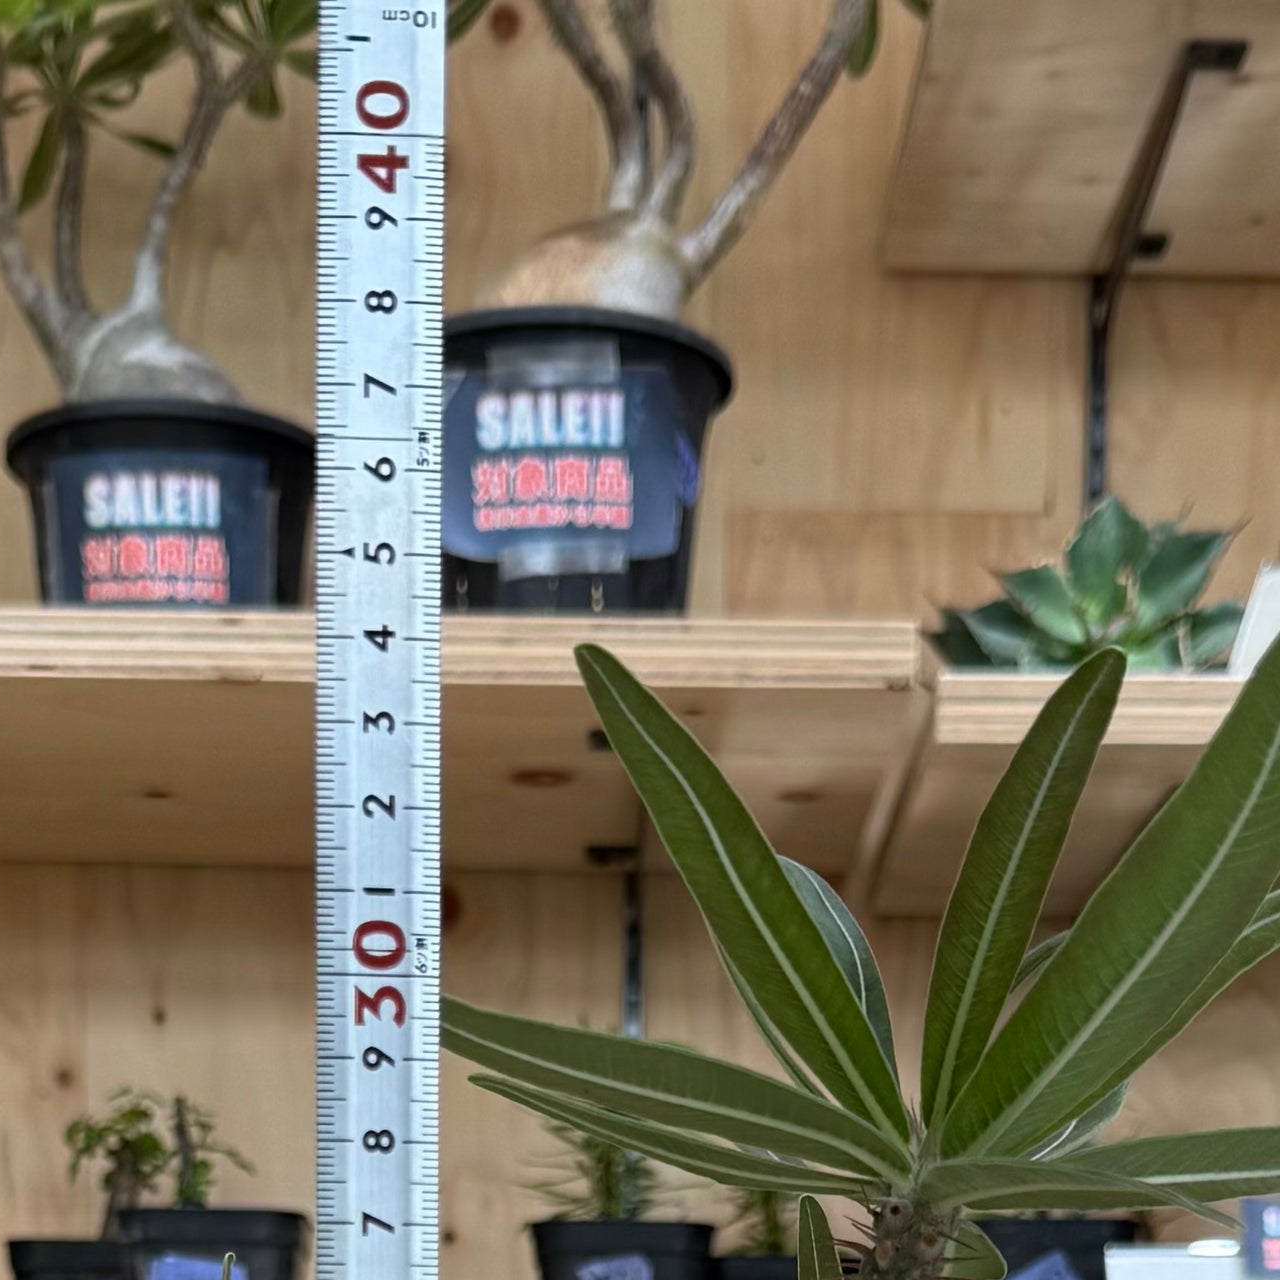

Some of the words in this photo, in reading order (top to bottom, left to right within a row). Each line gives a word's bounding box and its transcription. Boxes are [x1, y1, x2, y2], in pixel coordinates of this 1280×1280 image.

[381, 9, 438, 29] 10cm
[346, 34, 371, 42] 1
[355, 79, 411, 194] 40
[364, 206, 399, 230] 9
[364, 289, 398, 315] 8
[363, 373, 397, 398] 7
[363, 456, 396, 483] 6
[363, 541, 396, 566] 5
[363, 624, 396, 652] 4
[363, 711, 395, 734] 3
[362, 794, 396, 820] 2
[362, 887, 396, 896] 1
[352, 919, 407, 1027] 30
[362, 1046, 395, 1071] 9
[362, 1129, 395, 1154] 8
[362, 1211, 395, 1237] 7
